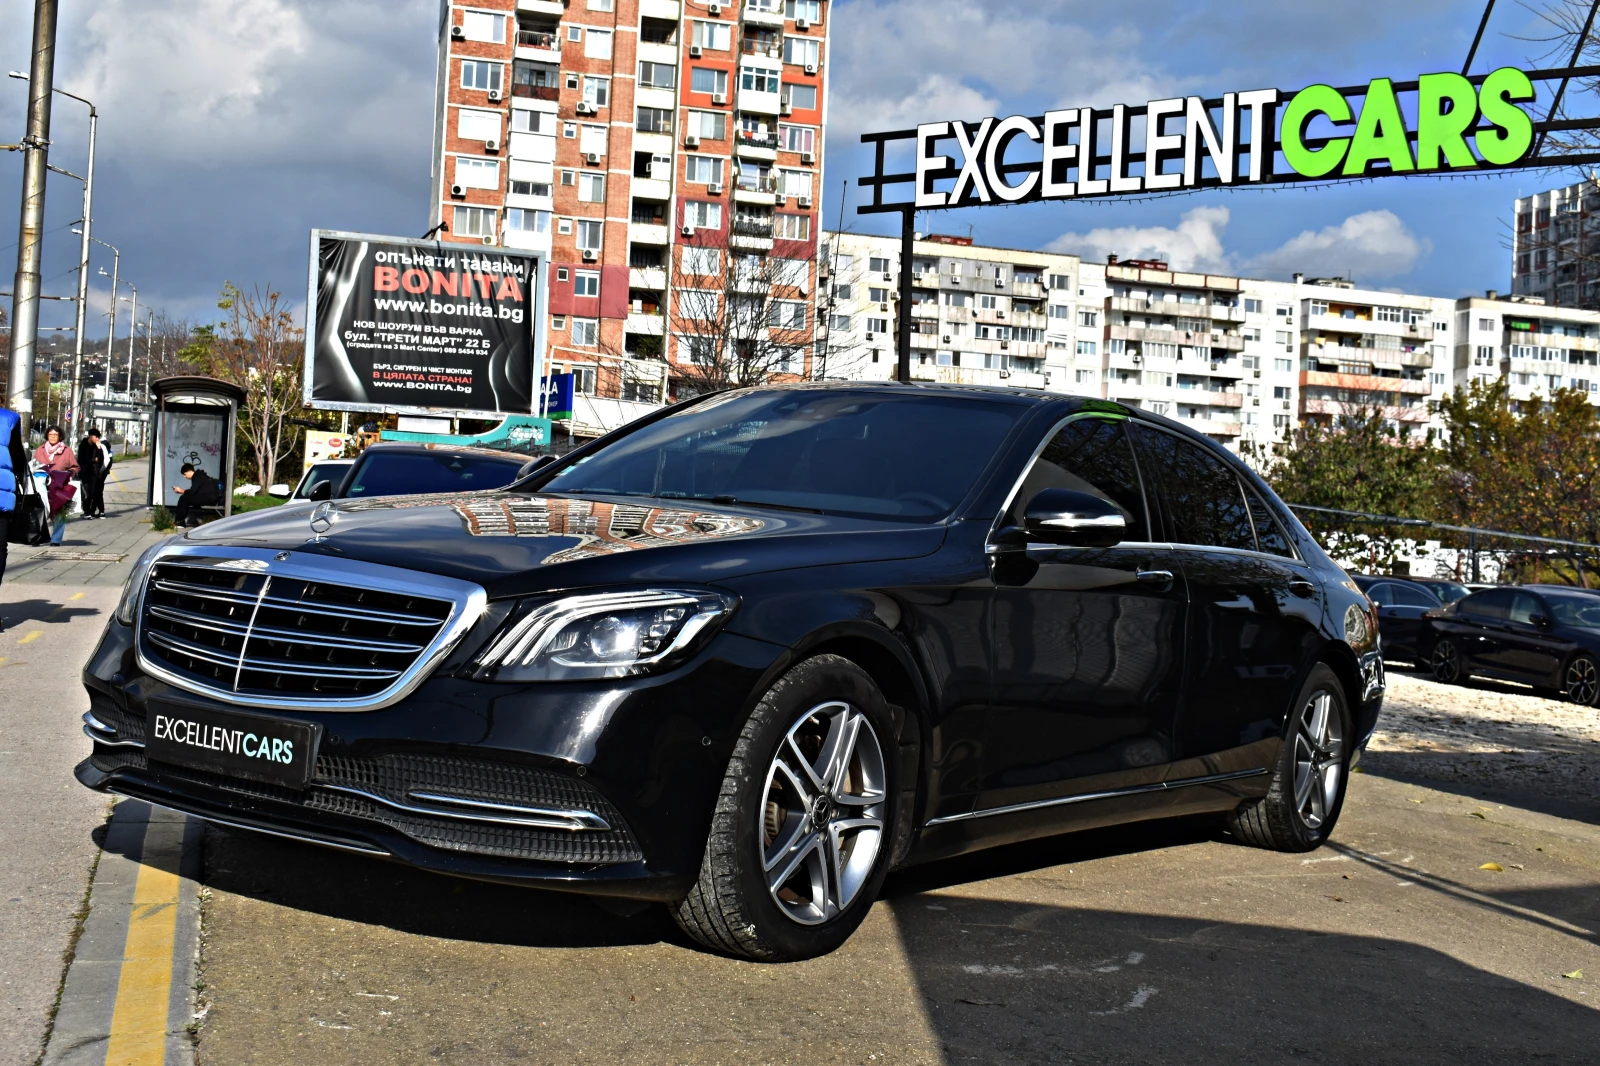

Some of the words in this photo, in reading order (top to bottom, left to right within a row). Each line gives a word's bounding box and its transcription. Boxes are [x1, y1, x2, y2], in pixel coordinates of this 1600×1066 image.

[375, 250, 456, 269] опънати
[460, 258, 524, 274] тавани
[374, 266, 524, 302] BONITA
[374, 298, 524, 323] www.bonita.bg
[354, 320, 376, 328] НОВ
[378, 322, 422, 332] ШОУРУМ
[424, 324, 446, 334] ВЪВ
[449, 326, 483, 336] ВАРНА
[344, 330, 370, 342] бул.
[466, 338, 479, 348] 22
[482, 340, 491, 348] Б
[417, 346, 442, 354] Center)
[383, 372, 426, 381] ЦЯЛАТА
[428, 374, 472, 384] СТРАНА!
[372, 381, 472, 394] www.BONITA.bg
